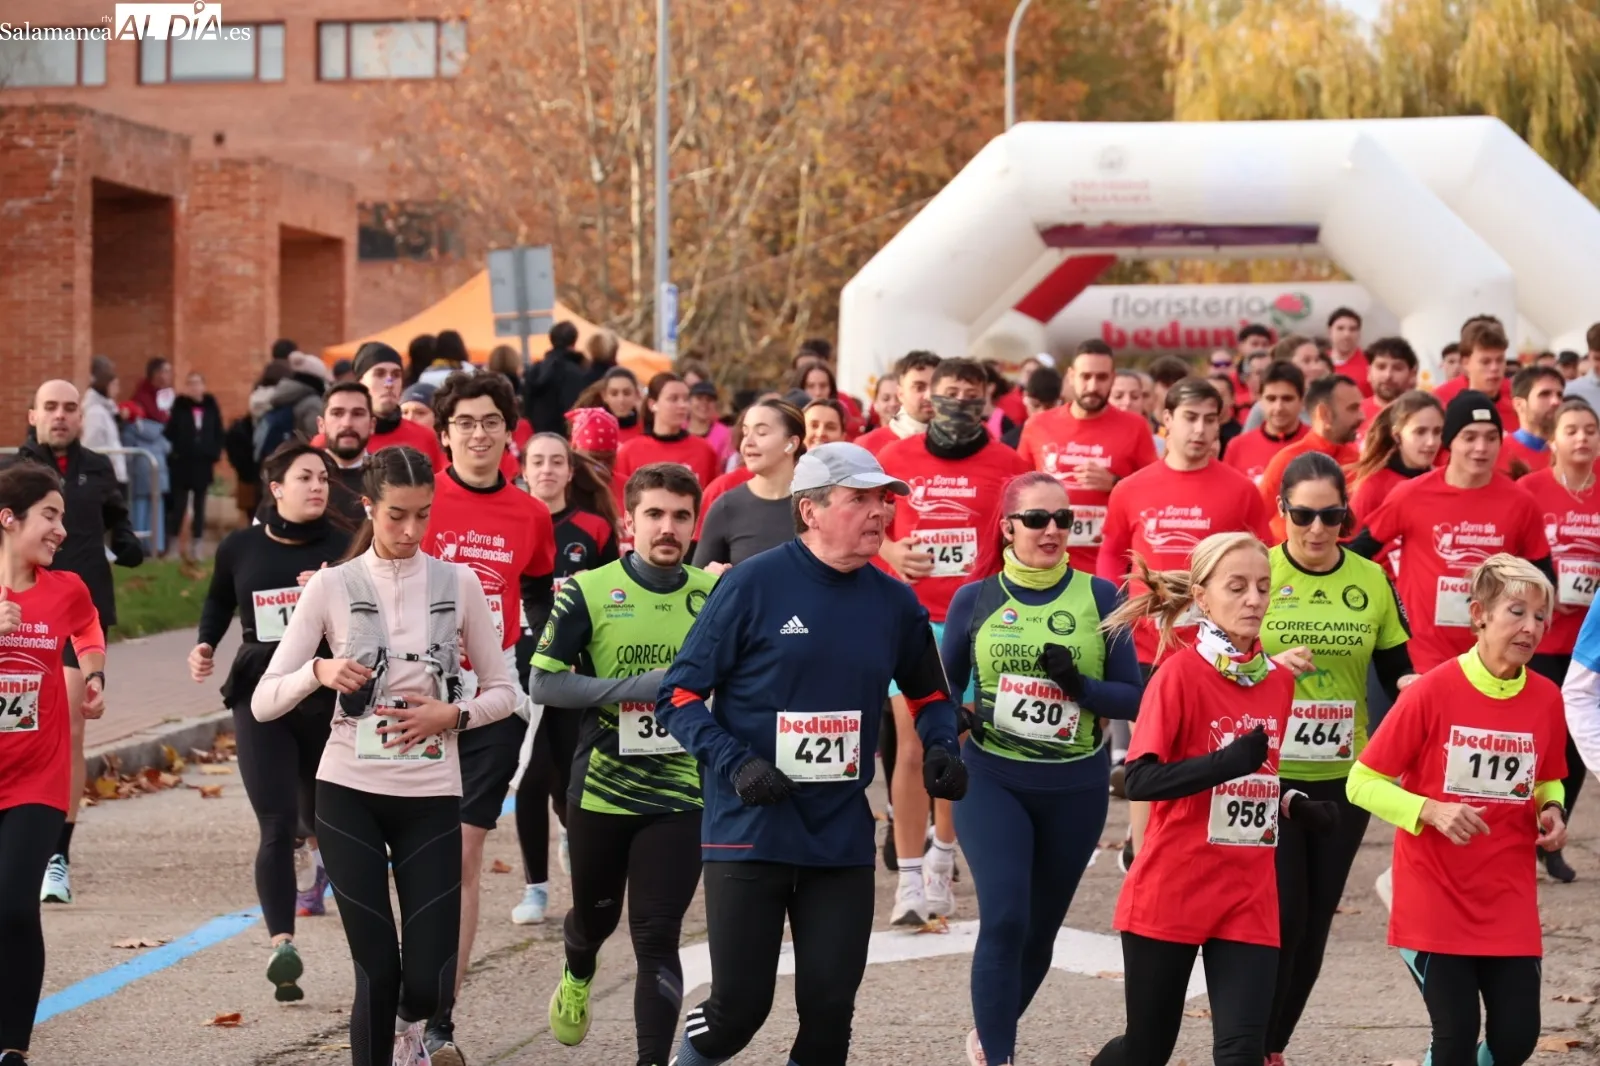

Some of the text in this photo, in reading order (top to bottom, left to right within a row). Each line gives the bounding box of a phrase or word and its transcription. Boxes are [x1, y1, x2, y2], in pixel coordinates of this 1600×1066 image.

[1069, 520, 1092, 535] 81
[467, 530, 505, 548] ¡Corre sin
[914, 532, 975, 544] edunia
[459, 545, 513, 564] resistencias!
[927, 546, 963, 565] 145
[1572, 576, 1600, 594] 42
[34, 622, 48, 635] sin
[1266, 621, 1371, 634] CORRECAMINOS
[0, 633, 58, 650] esistencias!
[1280, 634, 1363, 647] CARBAJOSA
[1011, 699, 1063, 726] 430
[1291, 705, 1353, 719] edunia
[779, 716, 859, 734] bedunia
[1295, 723, 1341, 746] 464
[1452, 730, 1533, 753] bedunia
[795, 737, 844, 763] 421
[1469, 753, 1520, 781] 119
[1227, 800, 1266, 828] 958
